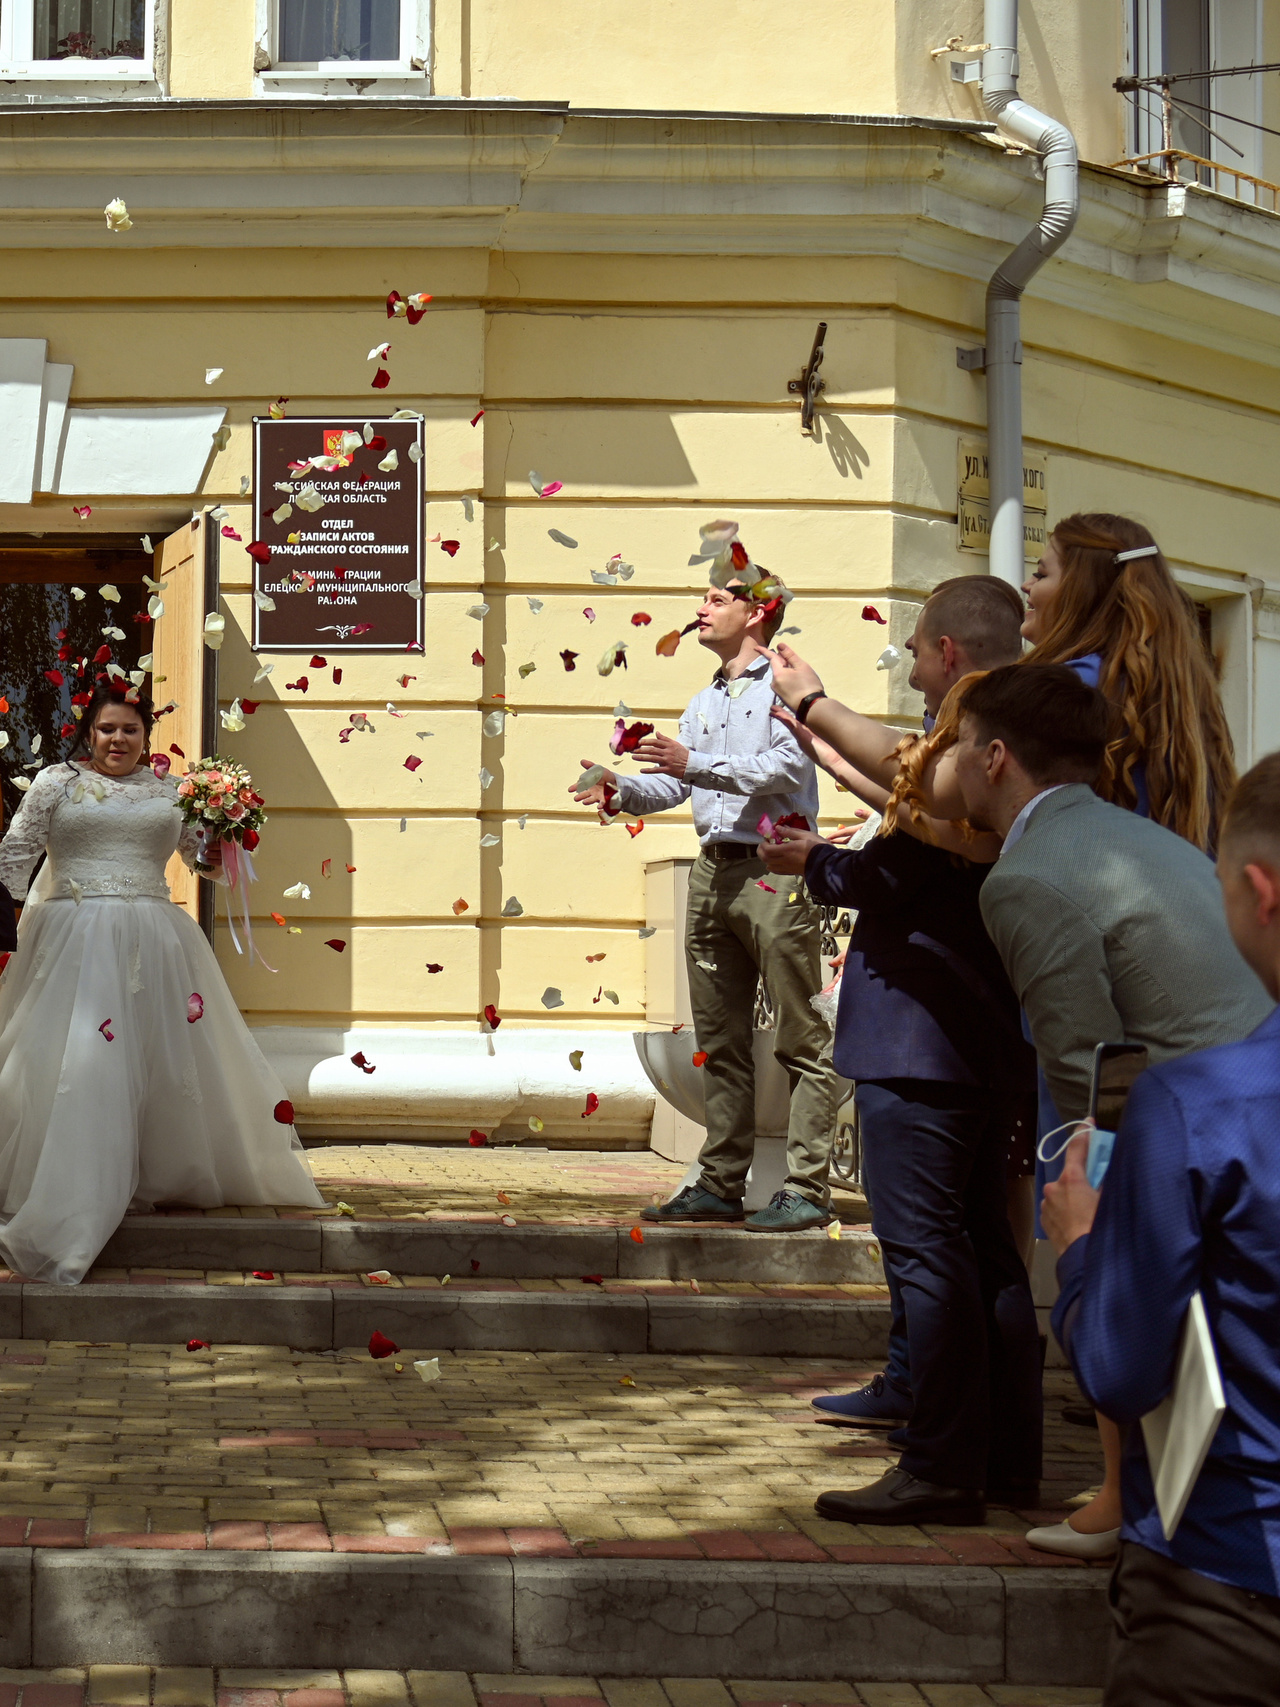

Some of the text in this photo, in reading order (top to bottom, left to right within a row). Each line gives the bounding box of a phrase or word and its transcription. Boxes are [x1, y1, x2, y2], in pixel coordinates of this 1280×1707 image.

[342, 481, 401, 492] ФЕДЕРАЦИЯ
[288, 494, 387, 503] ЛКАЯ ОБЛАСТЬ
[321, 519, 354, 530] ОТДЕЛ
[300, 532, 375, 541] ЗАПИСИ АКТОВ
[348, 545, 409, 554] СОСТОЯНИЯ
[264, 583, 314, 594] ЕЛЕЦКОО
